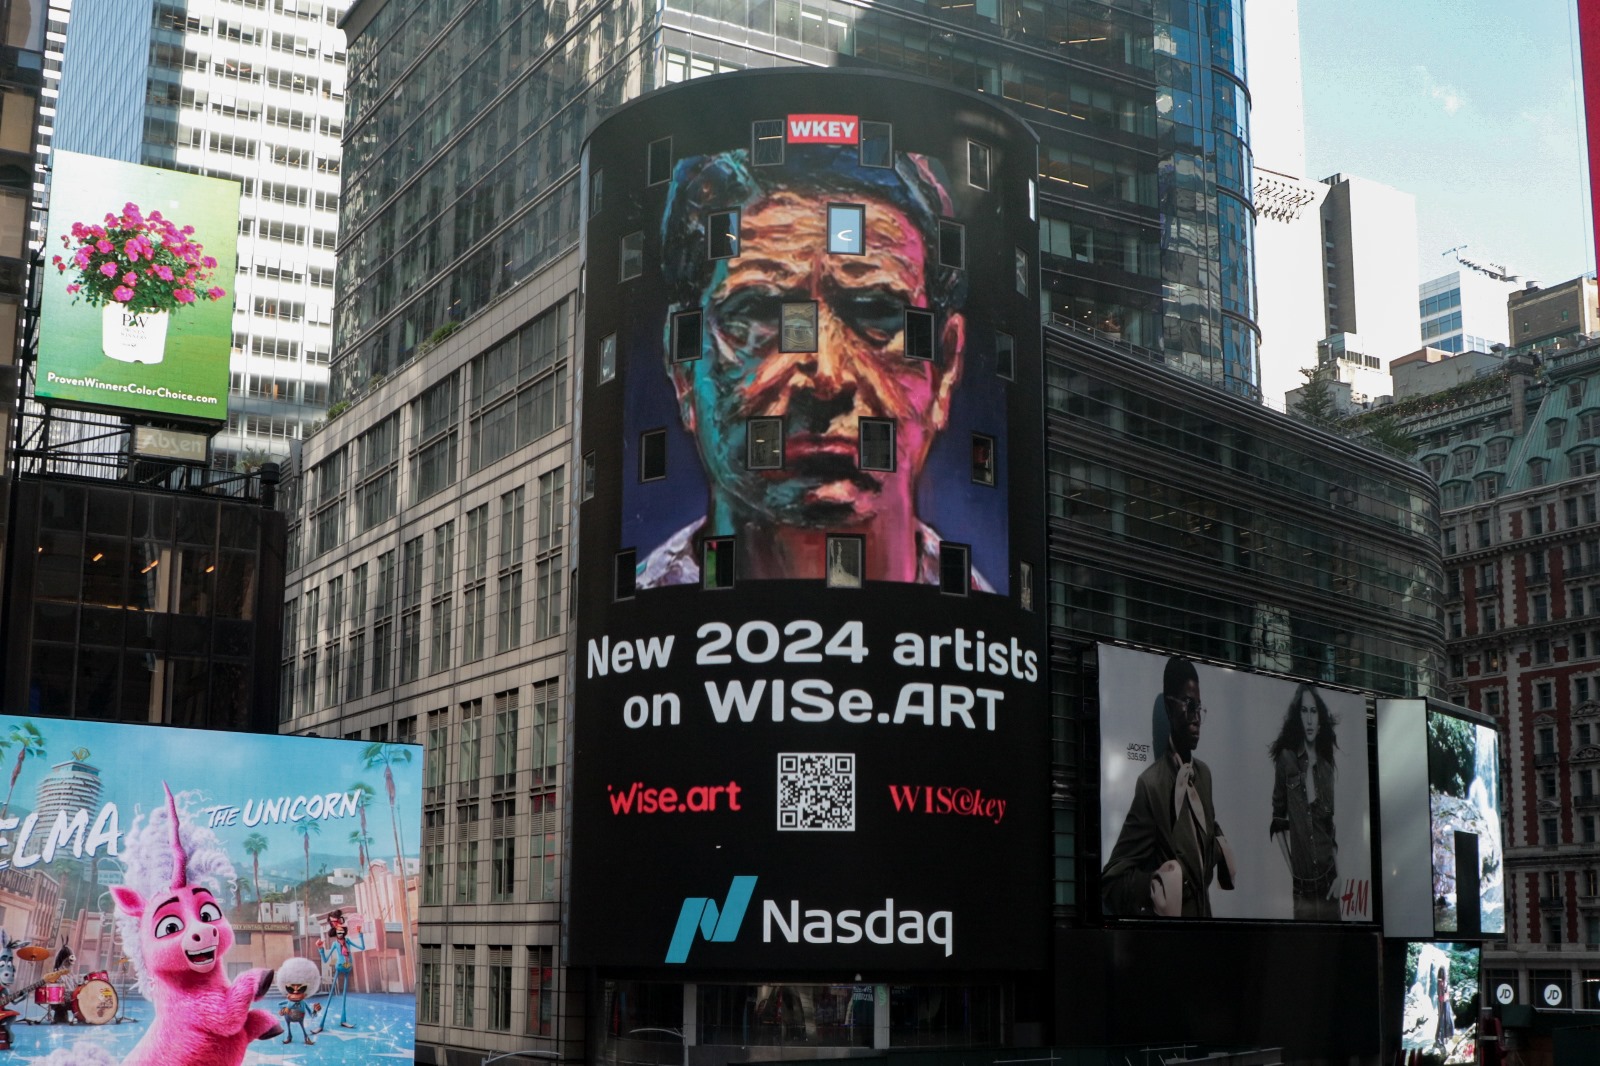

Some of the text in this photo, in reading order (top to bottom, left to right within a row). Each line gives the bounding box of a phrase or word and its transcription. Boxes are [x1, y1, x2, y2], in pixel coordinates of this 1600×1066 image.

[790, 121, 855, 138] WKEY
[47, 371, 218, 404] ProvenWinnersColorChoice.com
[142, 433, 203, 454] Absen
[587, 620, 1038, 683] New 2024 artists
[623, 679, 1005, 731] on WISe.ART
[1127, 742, 1150, 753] JACKET
[1127, 751, 1147, 761] $35.99
[205, 789, 362, 828] THE UNICORN
[1341, 878, 1369, 917] H&M
[763, 898, 953, 957] Nasdaq
[1499, 988, 1512, 999] JD
[1547, 989, 1560, 1000] JD
